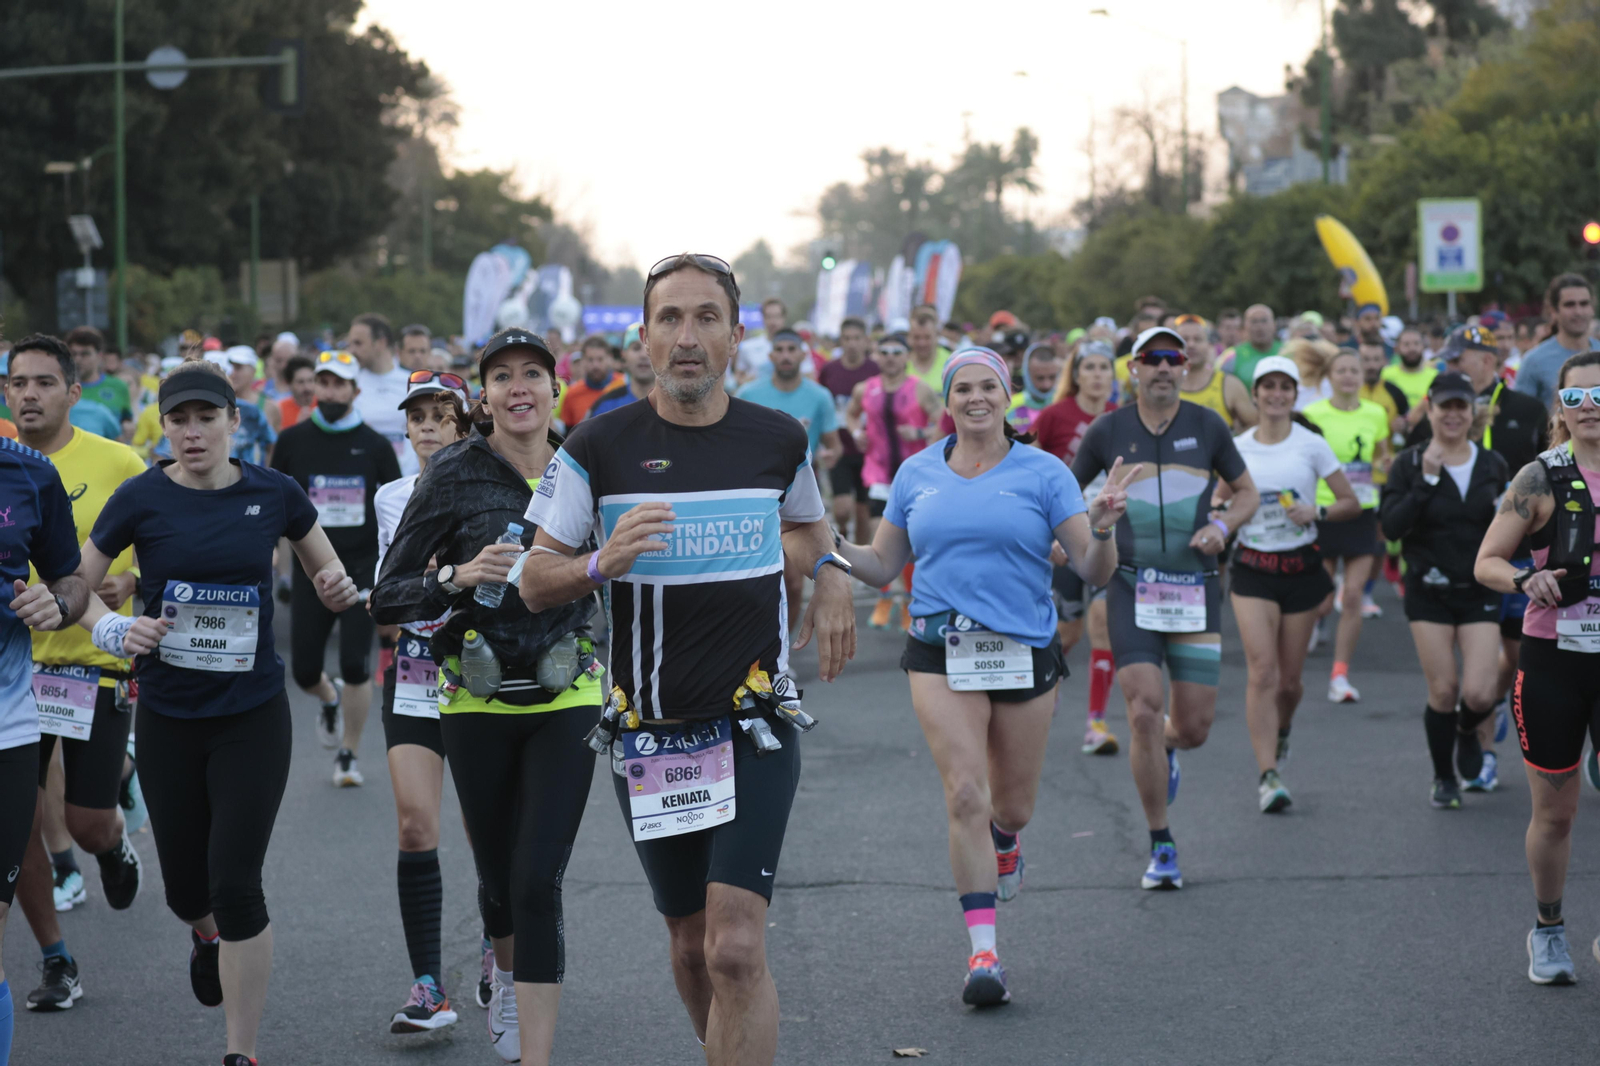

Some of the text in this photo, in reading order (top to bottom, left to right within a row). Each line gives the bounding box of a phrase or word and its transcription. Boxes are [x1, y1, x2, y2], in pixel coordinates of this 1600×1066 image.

[674, 516, 765, 538] TRIATLÓN
[676, 533, 764, 557] INDALO
[639, 549, 673, 558] NDALO
[195, 588, 250, 603] ZURICH
[1586, 602, 1600, 615] 72
[194, 615, 226, 630] 7986
[1580, 623, 1600, 633] VAL
[190, 637, 227, 650] SARAH
[975, 640, 1004, 653] 9530
[974, 659, 1006, 670] SOSSO
[424, 669, 437, 681] 71
[40, 684, 68, 699] 6854
[426, 688, 438, 699] LA
[36, 702, 75, 718] ALVADOR
[664, 765, 702, 784] 6869
[661, 789, 712, 809] KENIATA
